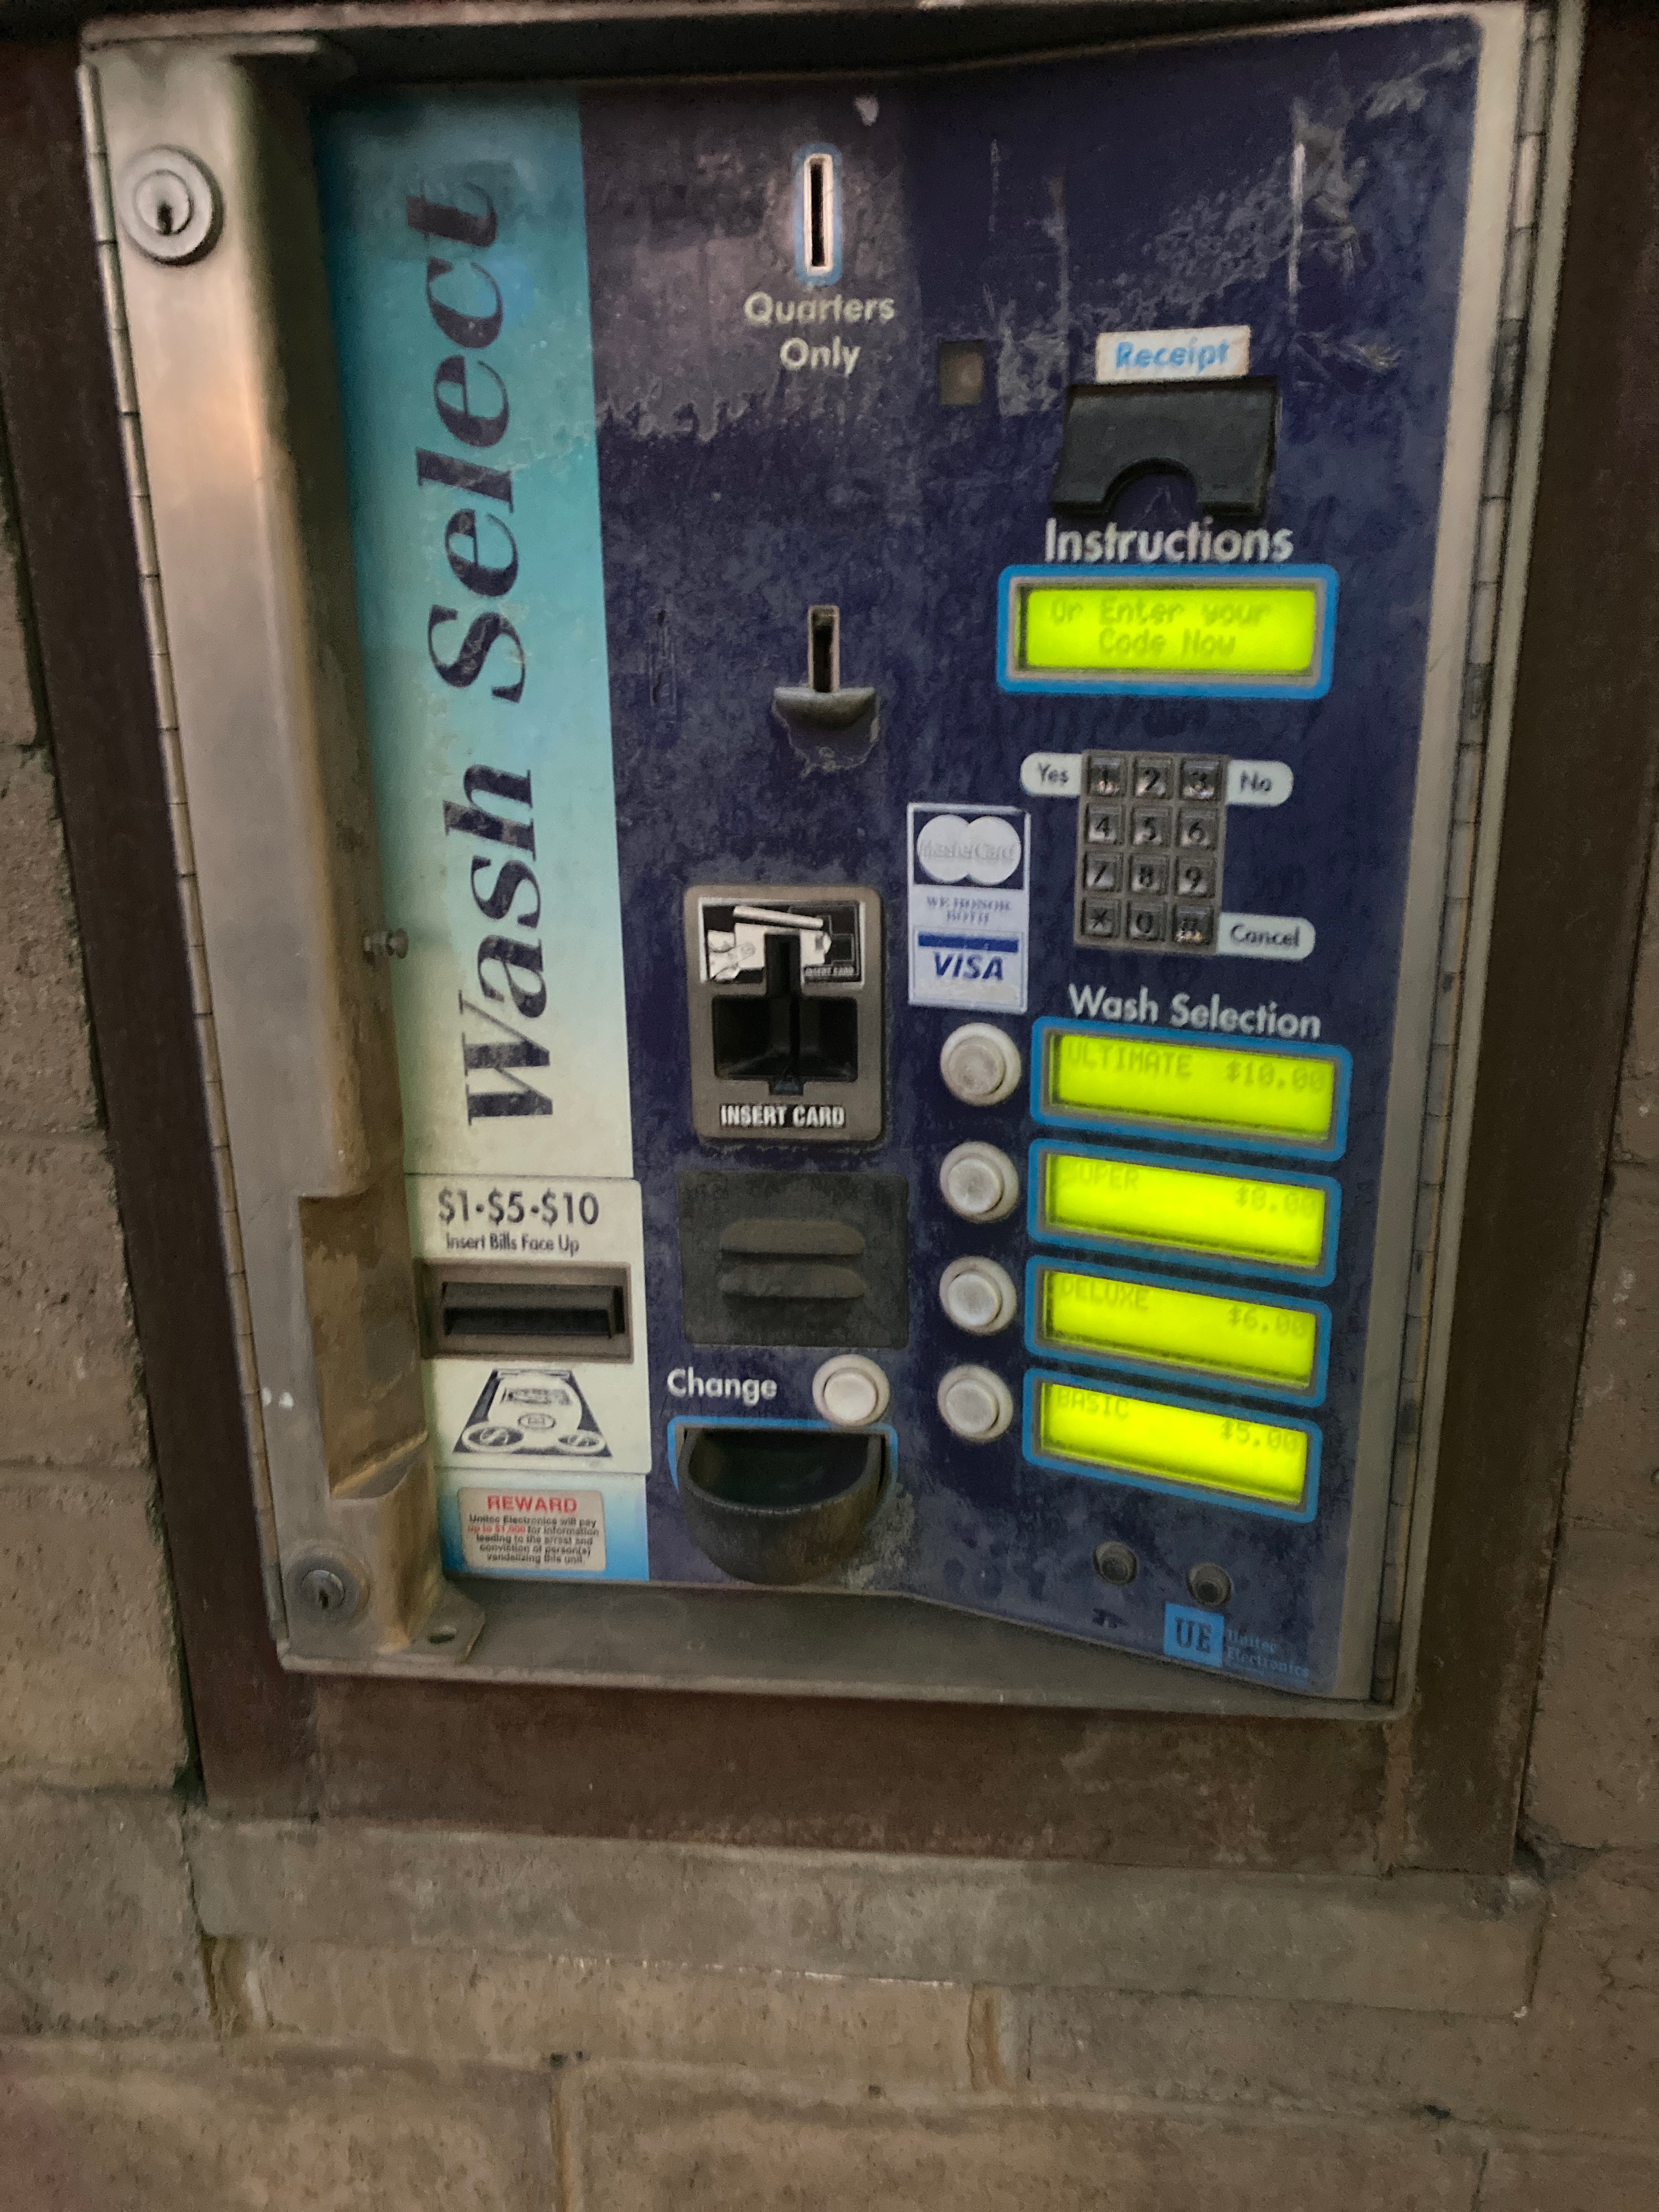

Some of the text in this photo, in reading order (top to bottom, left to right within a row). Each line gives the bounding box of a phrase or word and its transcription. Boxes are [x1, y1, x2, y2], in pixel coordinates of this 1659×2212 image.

[744, 291, 895, 324] Quarters
[780, 336, 861, 377] Only
[1115, 335, 1229, 374] Receipt
[1045, 516, 1294, 563] Instructions
[1051, 596, 1272, 629] Or Enter your
[407, 180, 553, 1125] Wash Select
[1098, 627, 1236, 658] Code Now
[1037, 762, 1069, 784] Yes
[1239, 771, 1272, 794] No
[1230, 923, 1300, 947] Cancel
[933, 952, 1005, 981] VISA
[1069, 983, 1321, 1039] Wash Selection
[1066, 1040, 1327, 1093] ULTIMATE $10.00
[720, 1104, 845, 1128] INSERT CARD
[446, 1231, 580, 1256] Insert Bills Face Up
[1060, 1276, 1308, 1339] DELUXE $6.00
[667, 1366, 778, 1407] Change
[1056, 1389, 1298, 1453] BASIC $5.00
[487, 1495, 578, 1513] REWARD
[503, 1515, 557, 1525] Electronics
[560, 1517, 577, 1525] will
[579, 1519, 596, 1528] pay
[528, 1525, 541, 1534] for
[544, 1525, 600, 1537] information
[575, 1537, 593, 1546] and
[1175, 1616, 1212, 1655] UE
[1227, 1646, 1310, 1678] Electronics
